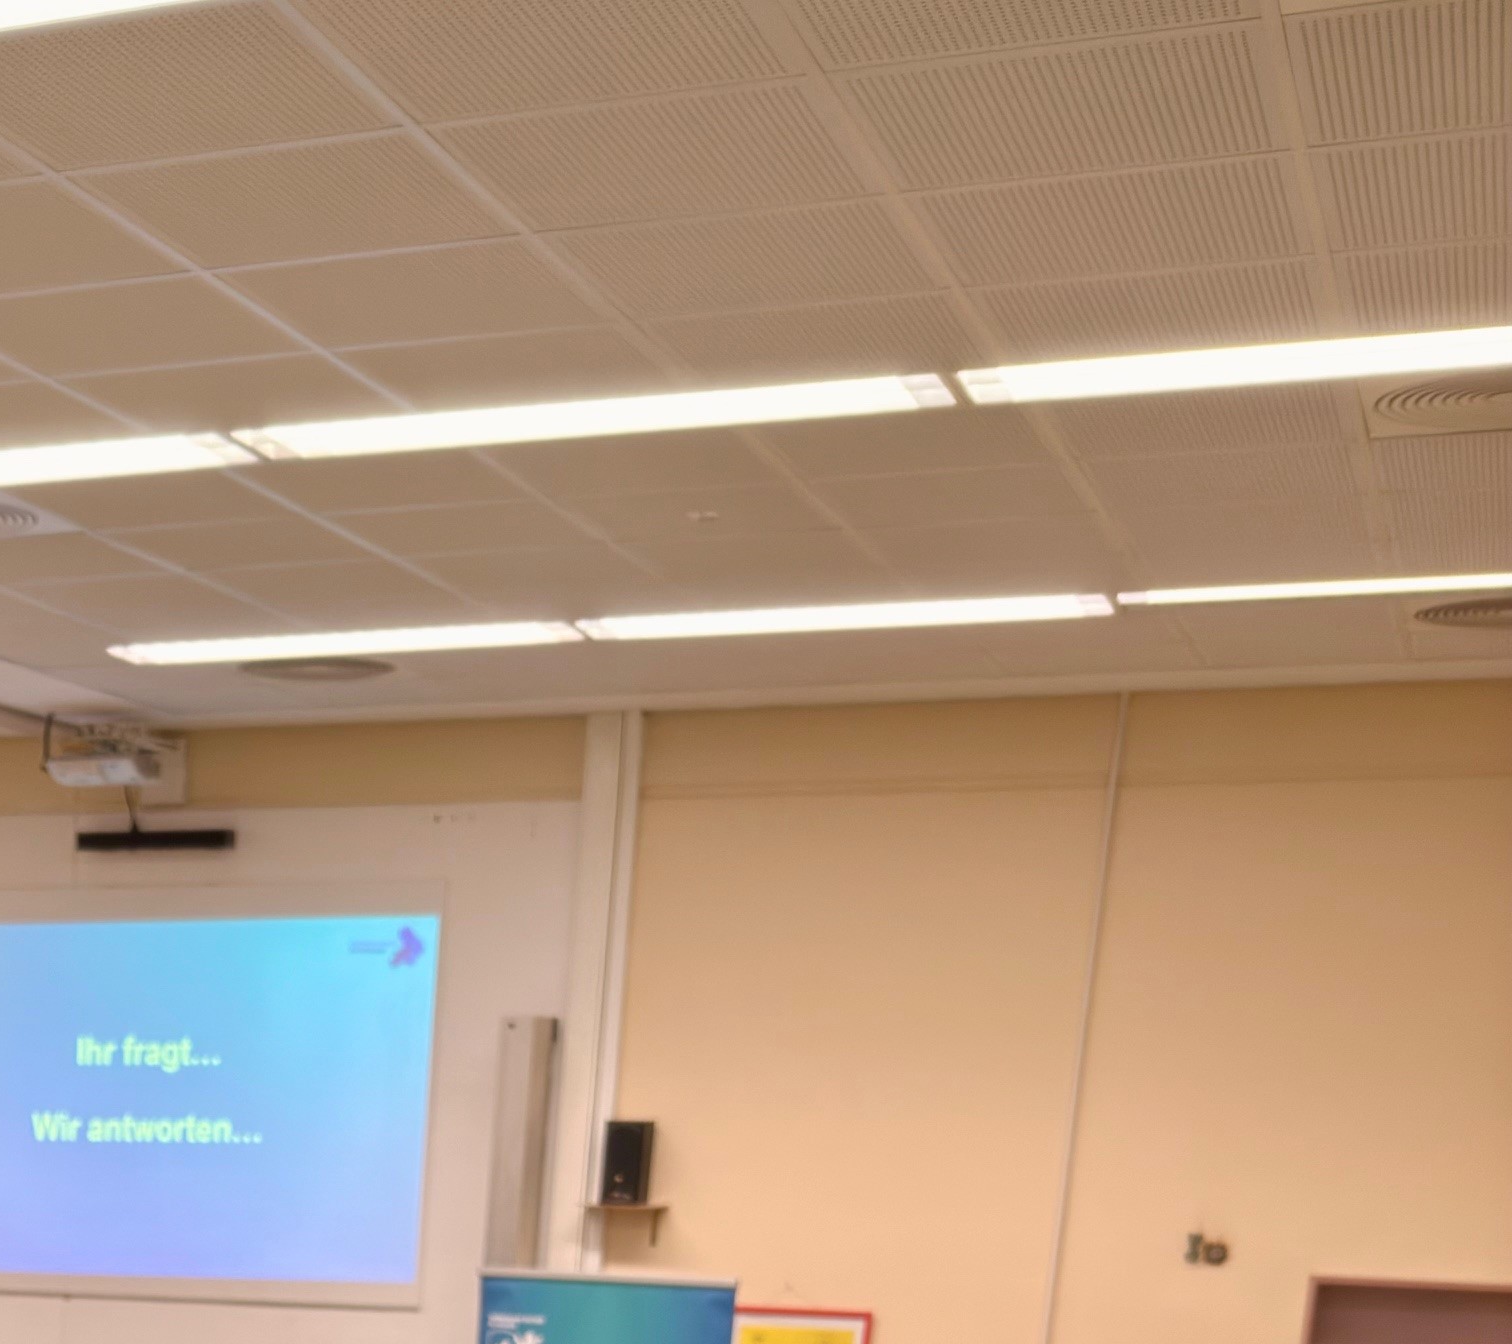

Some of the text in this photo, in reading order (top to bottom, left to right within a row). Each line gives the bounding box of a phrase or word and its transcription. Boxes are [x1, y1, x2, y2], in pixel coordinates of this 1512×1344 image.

[76, 1034, 221, 1073] Ihr fragt...
[31, 1111, 262, 1143] Wir antworten...
